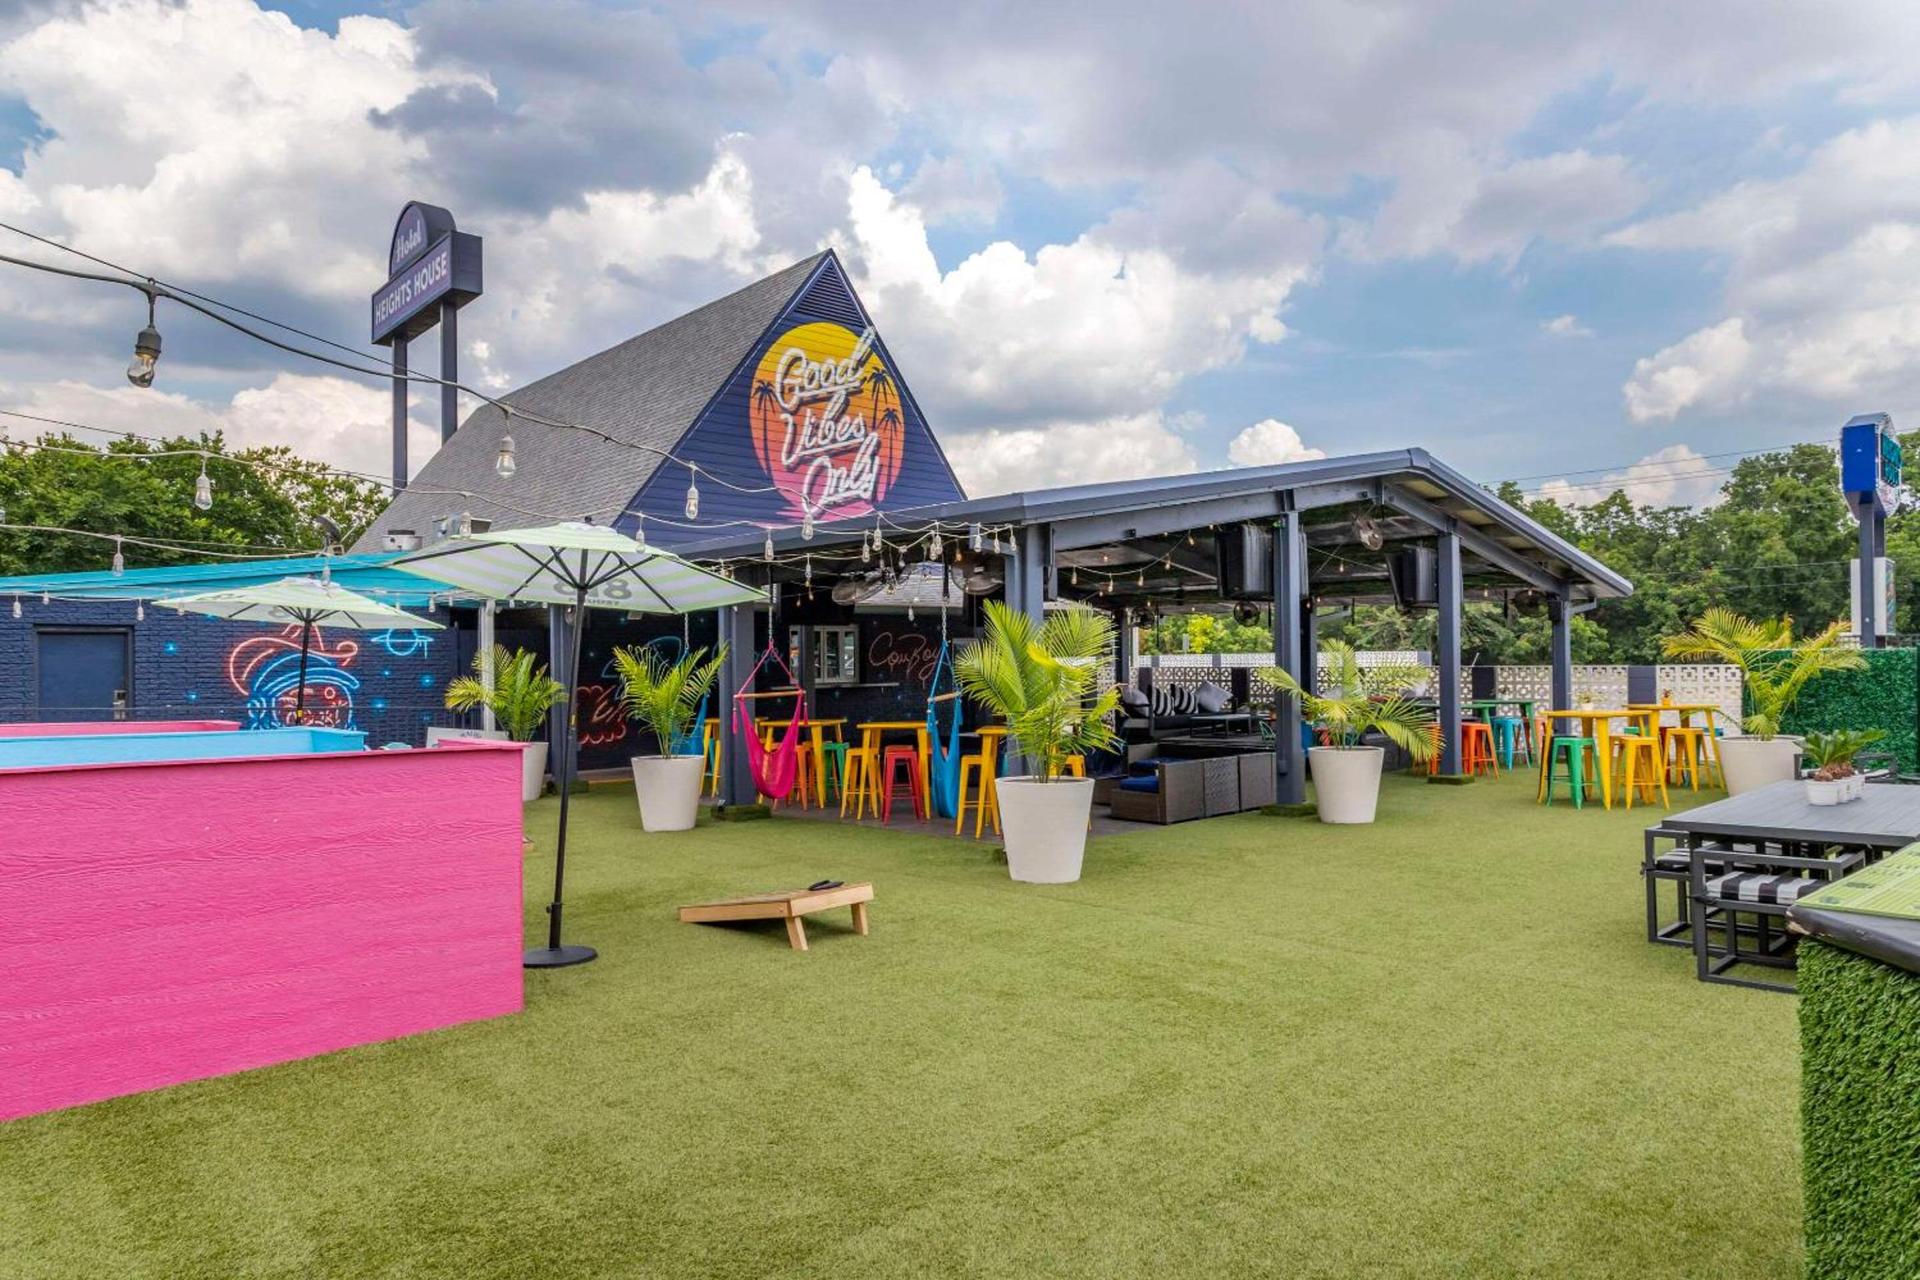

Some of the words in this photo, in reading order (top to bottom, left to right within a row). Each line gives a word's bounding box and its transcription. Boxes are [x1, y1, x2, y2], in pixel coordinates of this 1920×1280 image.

[396, 219, 422, 263] Hotel
[375, 279, 412, 325] HEIGHTS
[414, 251, 448, 295] HOUSE
[775, 325, 876, 411] Good
[780, 388, 866, 467] Vibes
[802, 431, 880, 515] Only
